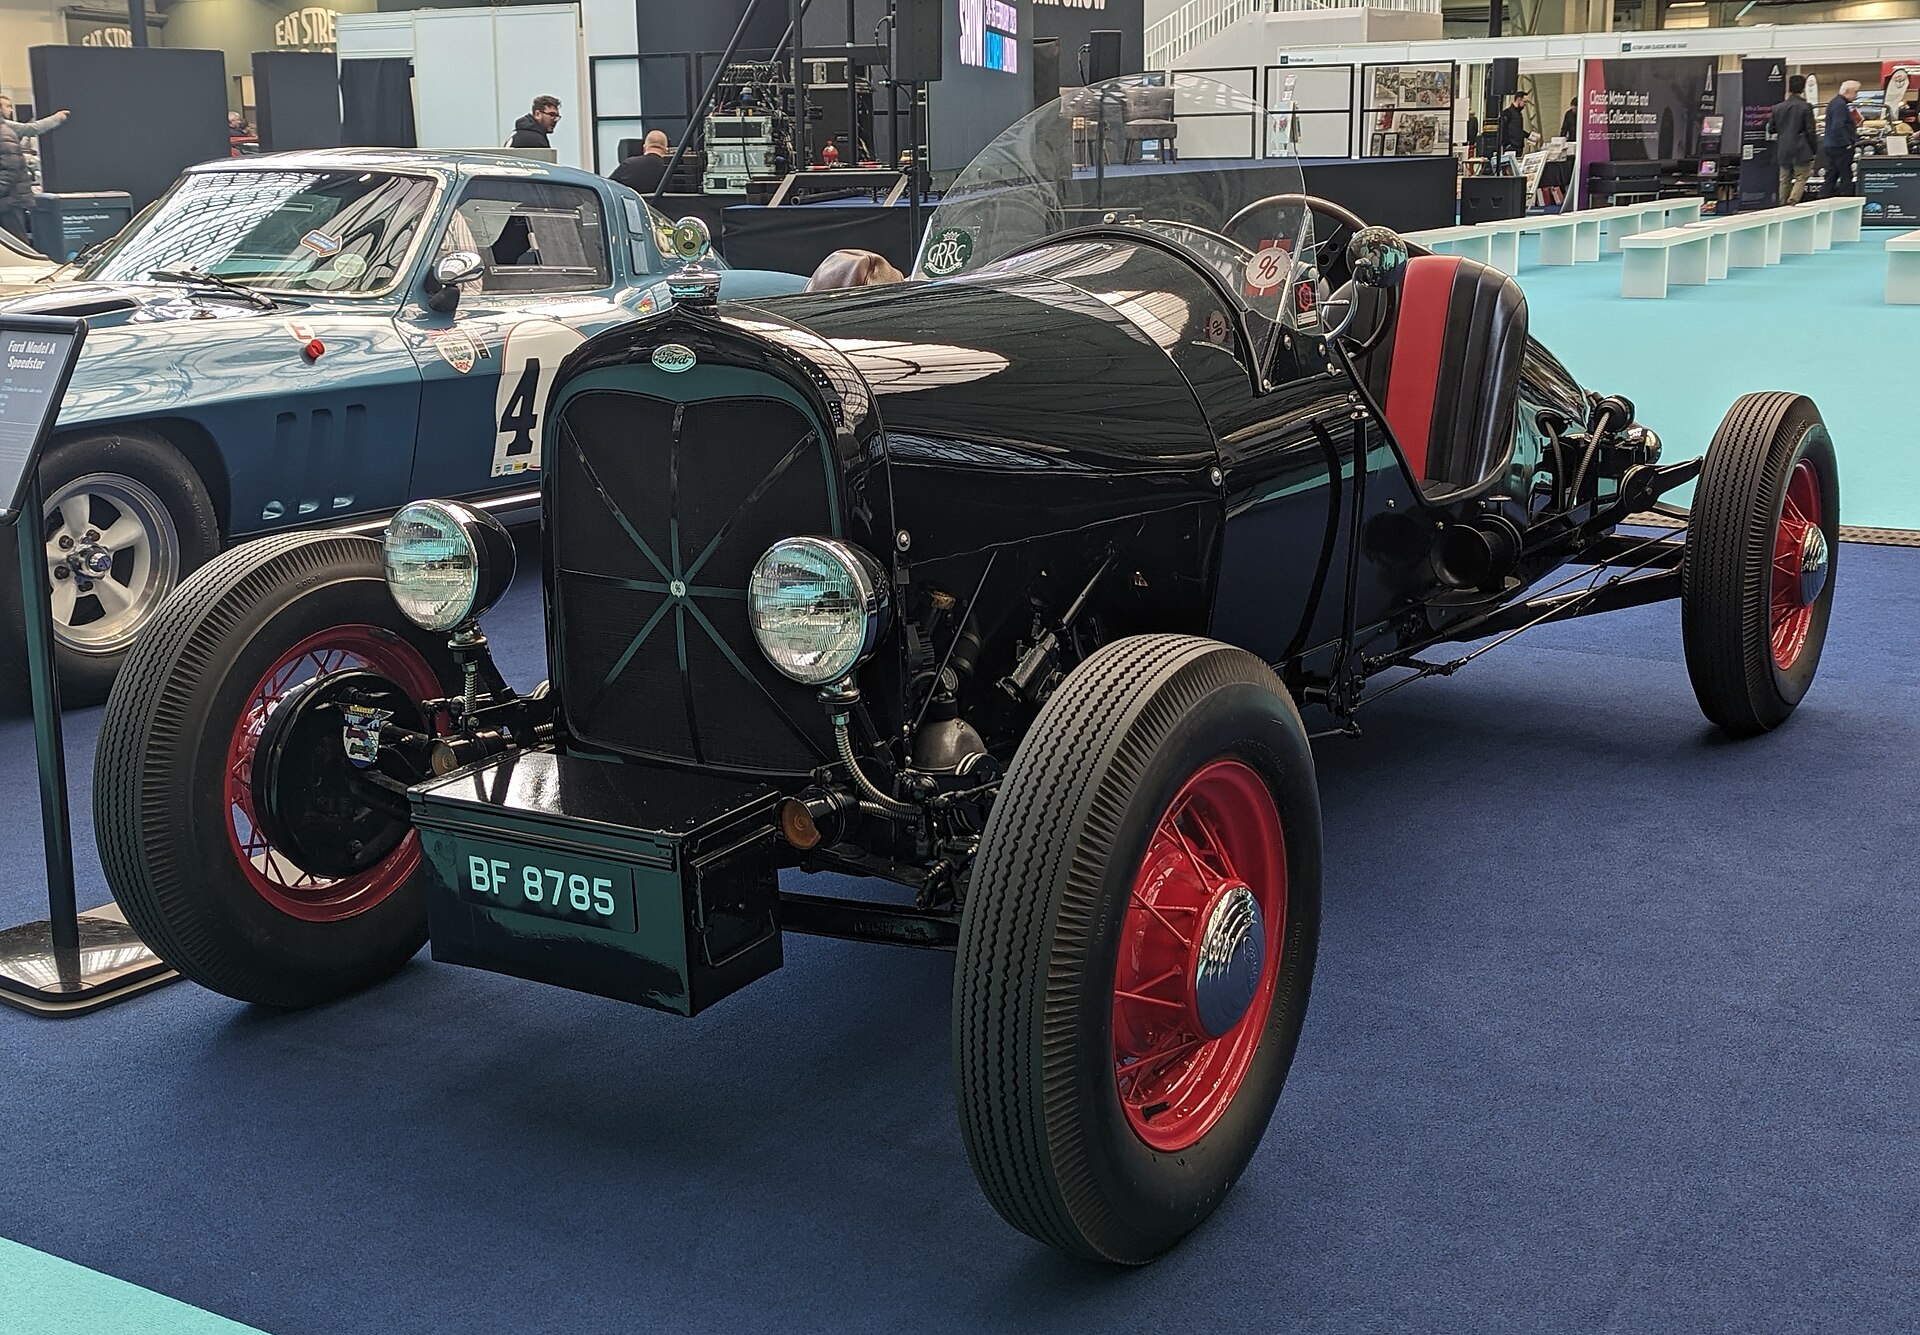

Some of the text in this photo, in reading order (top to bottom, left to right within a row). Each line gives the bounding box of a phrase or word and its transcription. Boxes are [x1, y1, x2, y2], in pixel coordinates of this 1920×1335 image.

[275, 7, 341, 45] EAT STRE
[1589, 89, 1650, 106] Classic Motor Trade and
[1588, 108, 1657, 124] Private Collectors Insurance
[927, 241, 966, 269] GRRC
[1256, 255, 1281, 280] 96
[8, 340, 56, 355] Ford Model A
[654, 350, 694, 365] Ford
[7, 355, 46, 370] Speedster
[499, 357, 541, 456] 4
[469, 855, 615, 916] BF 8785
